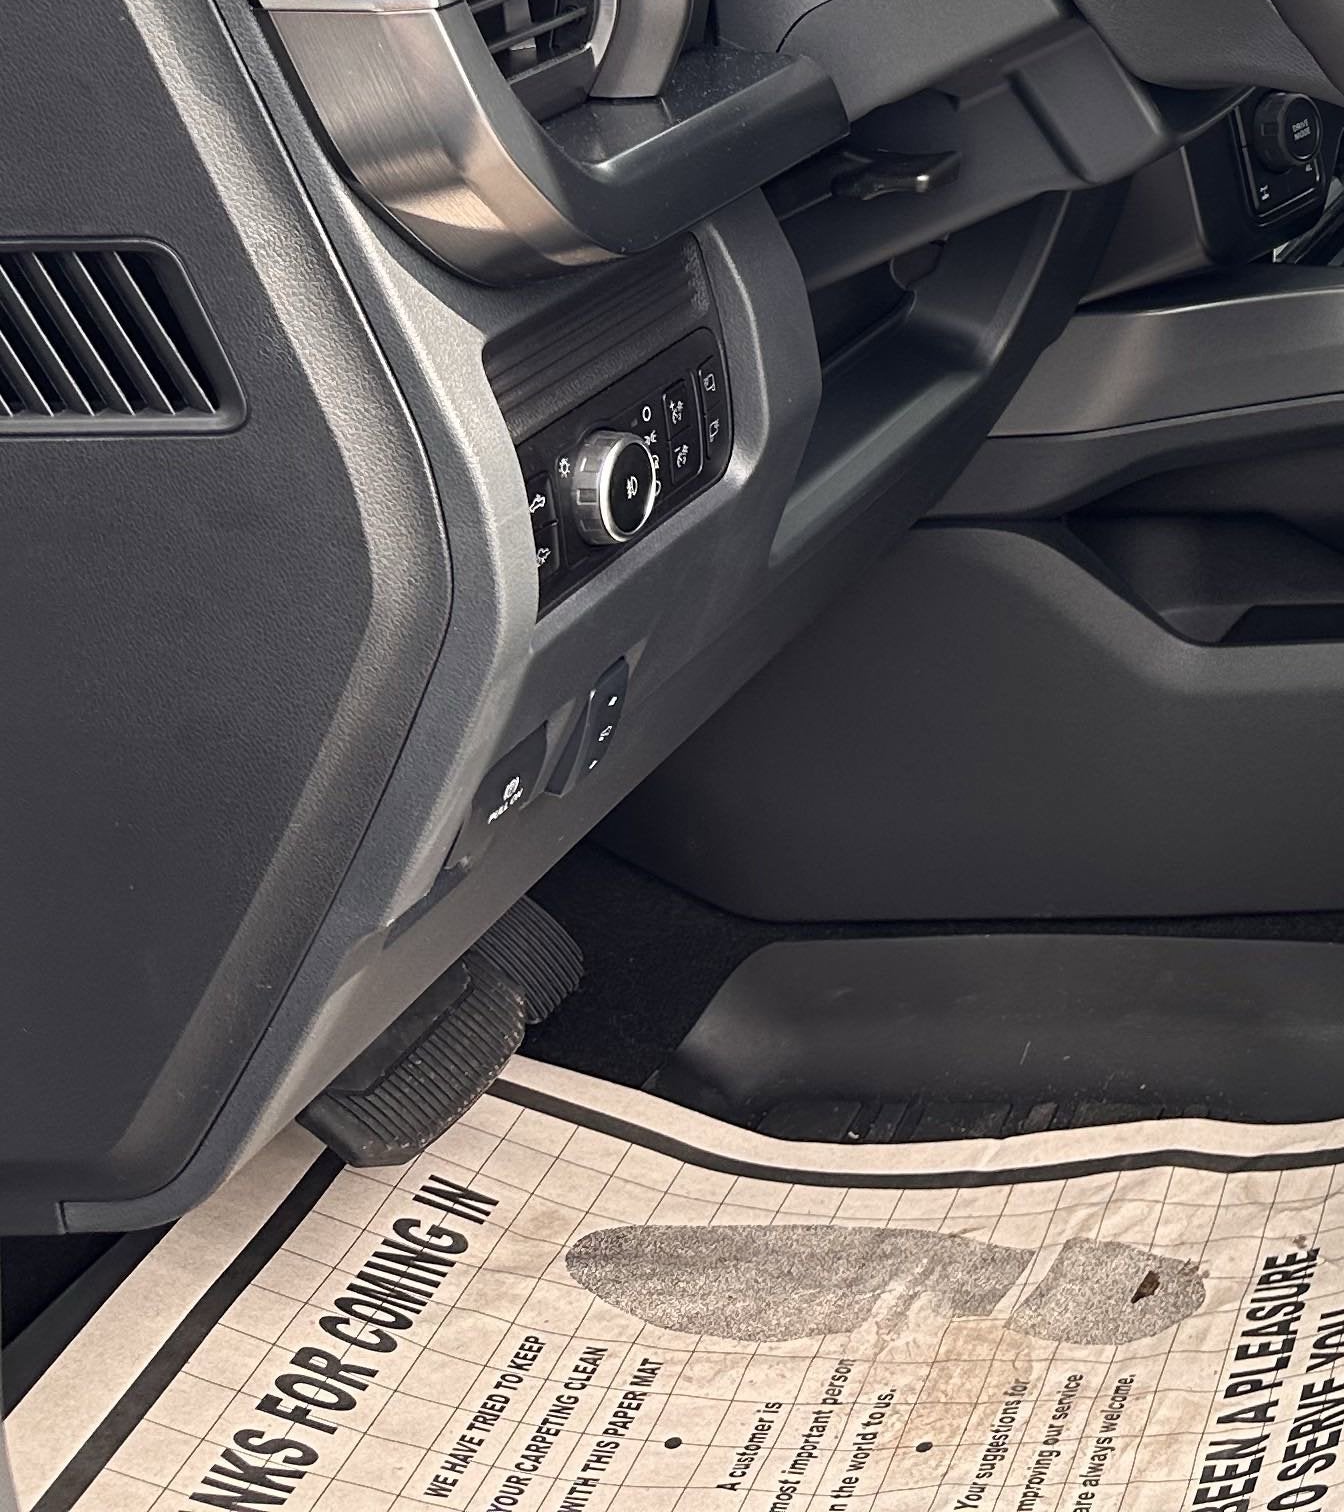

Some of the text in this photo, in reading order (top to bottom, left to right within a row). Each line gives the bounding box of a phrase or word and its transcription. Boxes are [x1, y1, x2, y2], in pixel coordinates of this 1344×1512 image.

[488, 801, 509, 824] PULL
[178, 1174, 500, 1512] NKS FOR COMING IN
[1191, 1247, 1321, 1512] BEEN A PLEASURE
[423, 1335, 547, 1498] WE HAVE TRIED TO KEEP
[487, 1346, 608, 1512] YOUR CARPETING CLEAN
[557, 1358, 665, 1512] WITH THIS PAPER MAT
[769, 1358, 857, 1512] most important person
[861, 1411, 886, 1428] to
[873, 1387, 897, 1411] us.
[1043, 1423, 1065, 1446] our
[1052, 1373, 1085, 1420] service
[715, 1401, 783, 1492] A customer is
[830, 1476, 860, 1499] the
[846, 1431, 878, 1472] world
[953, 1378, 1031, 1511] Your suggestions for
[1072, 1373, 1137, 1512] are always welcome.
[1266, 1484, 1330, 1512] O
